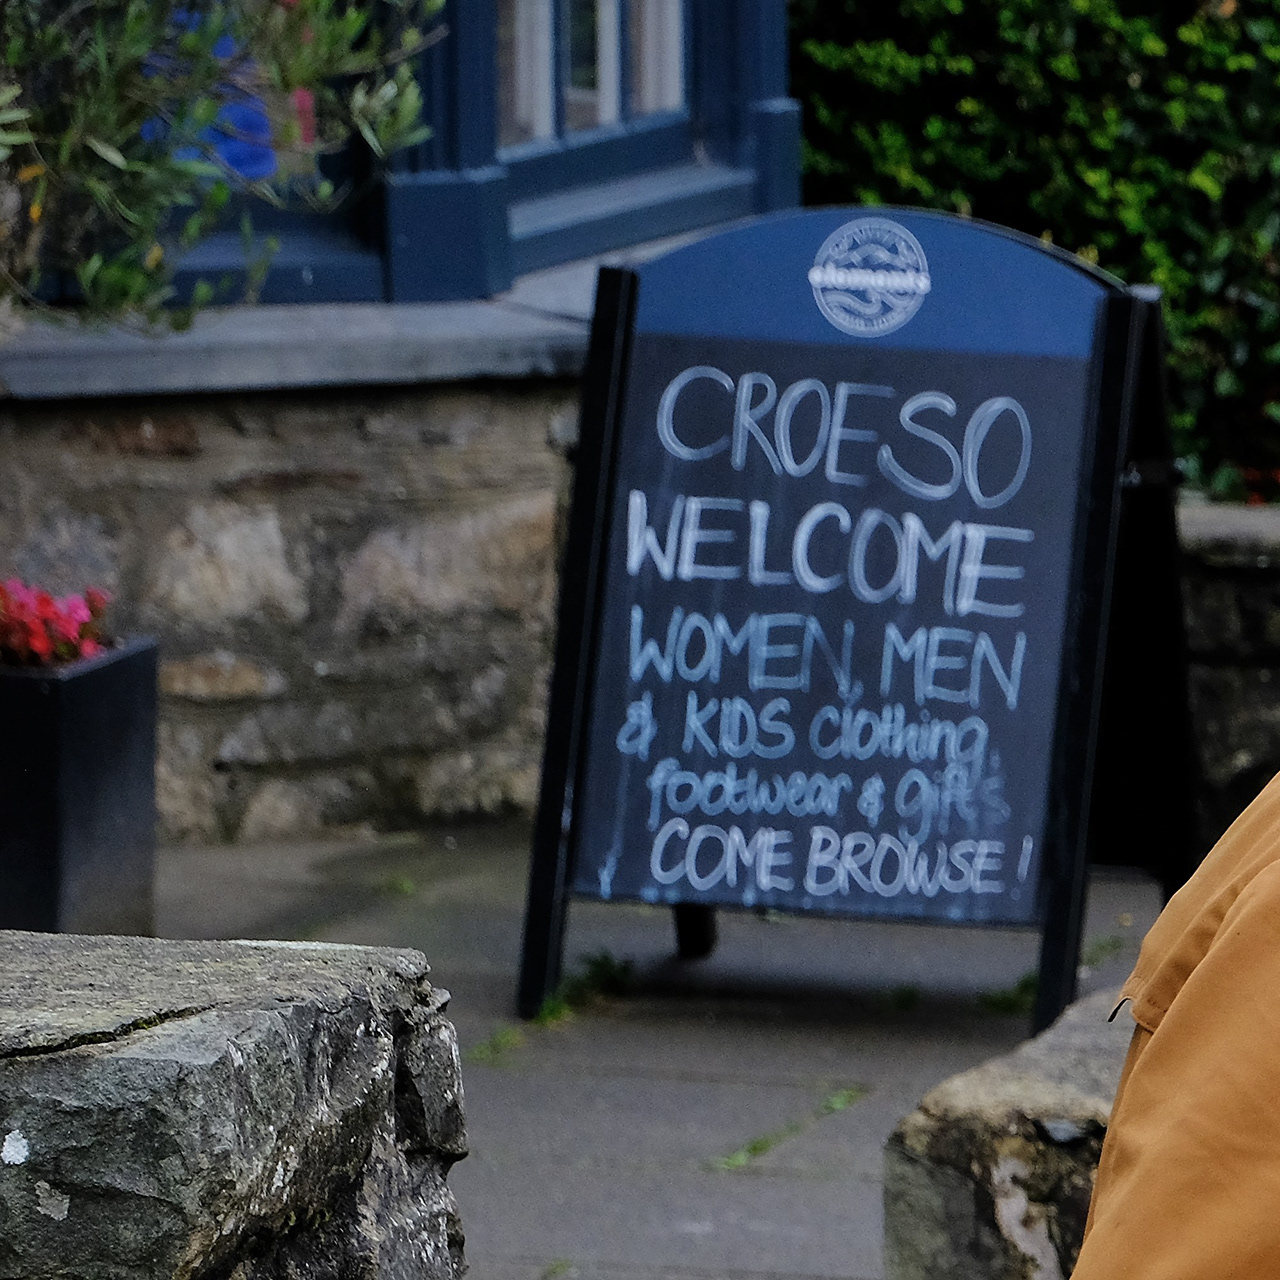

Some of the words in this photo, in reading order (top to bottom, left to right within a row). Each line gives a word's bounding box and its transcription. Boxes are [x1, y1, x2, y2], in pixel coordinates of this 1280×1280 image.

[656, 365, 1032, 509] CROESO
[627, 489, 1036, 619] WELCOME
[880, 622, 1028, 709] MEN
[616, 690, 658, 761] &
[682, 690, 797, 758] KIDS
[647, 757, 853, 831] footwear
[650, 817, 795, 891] COME
